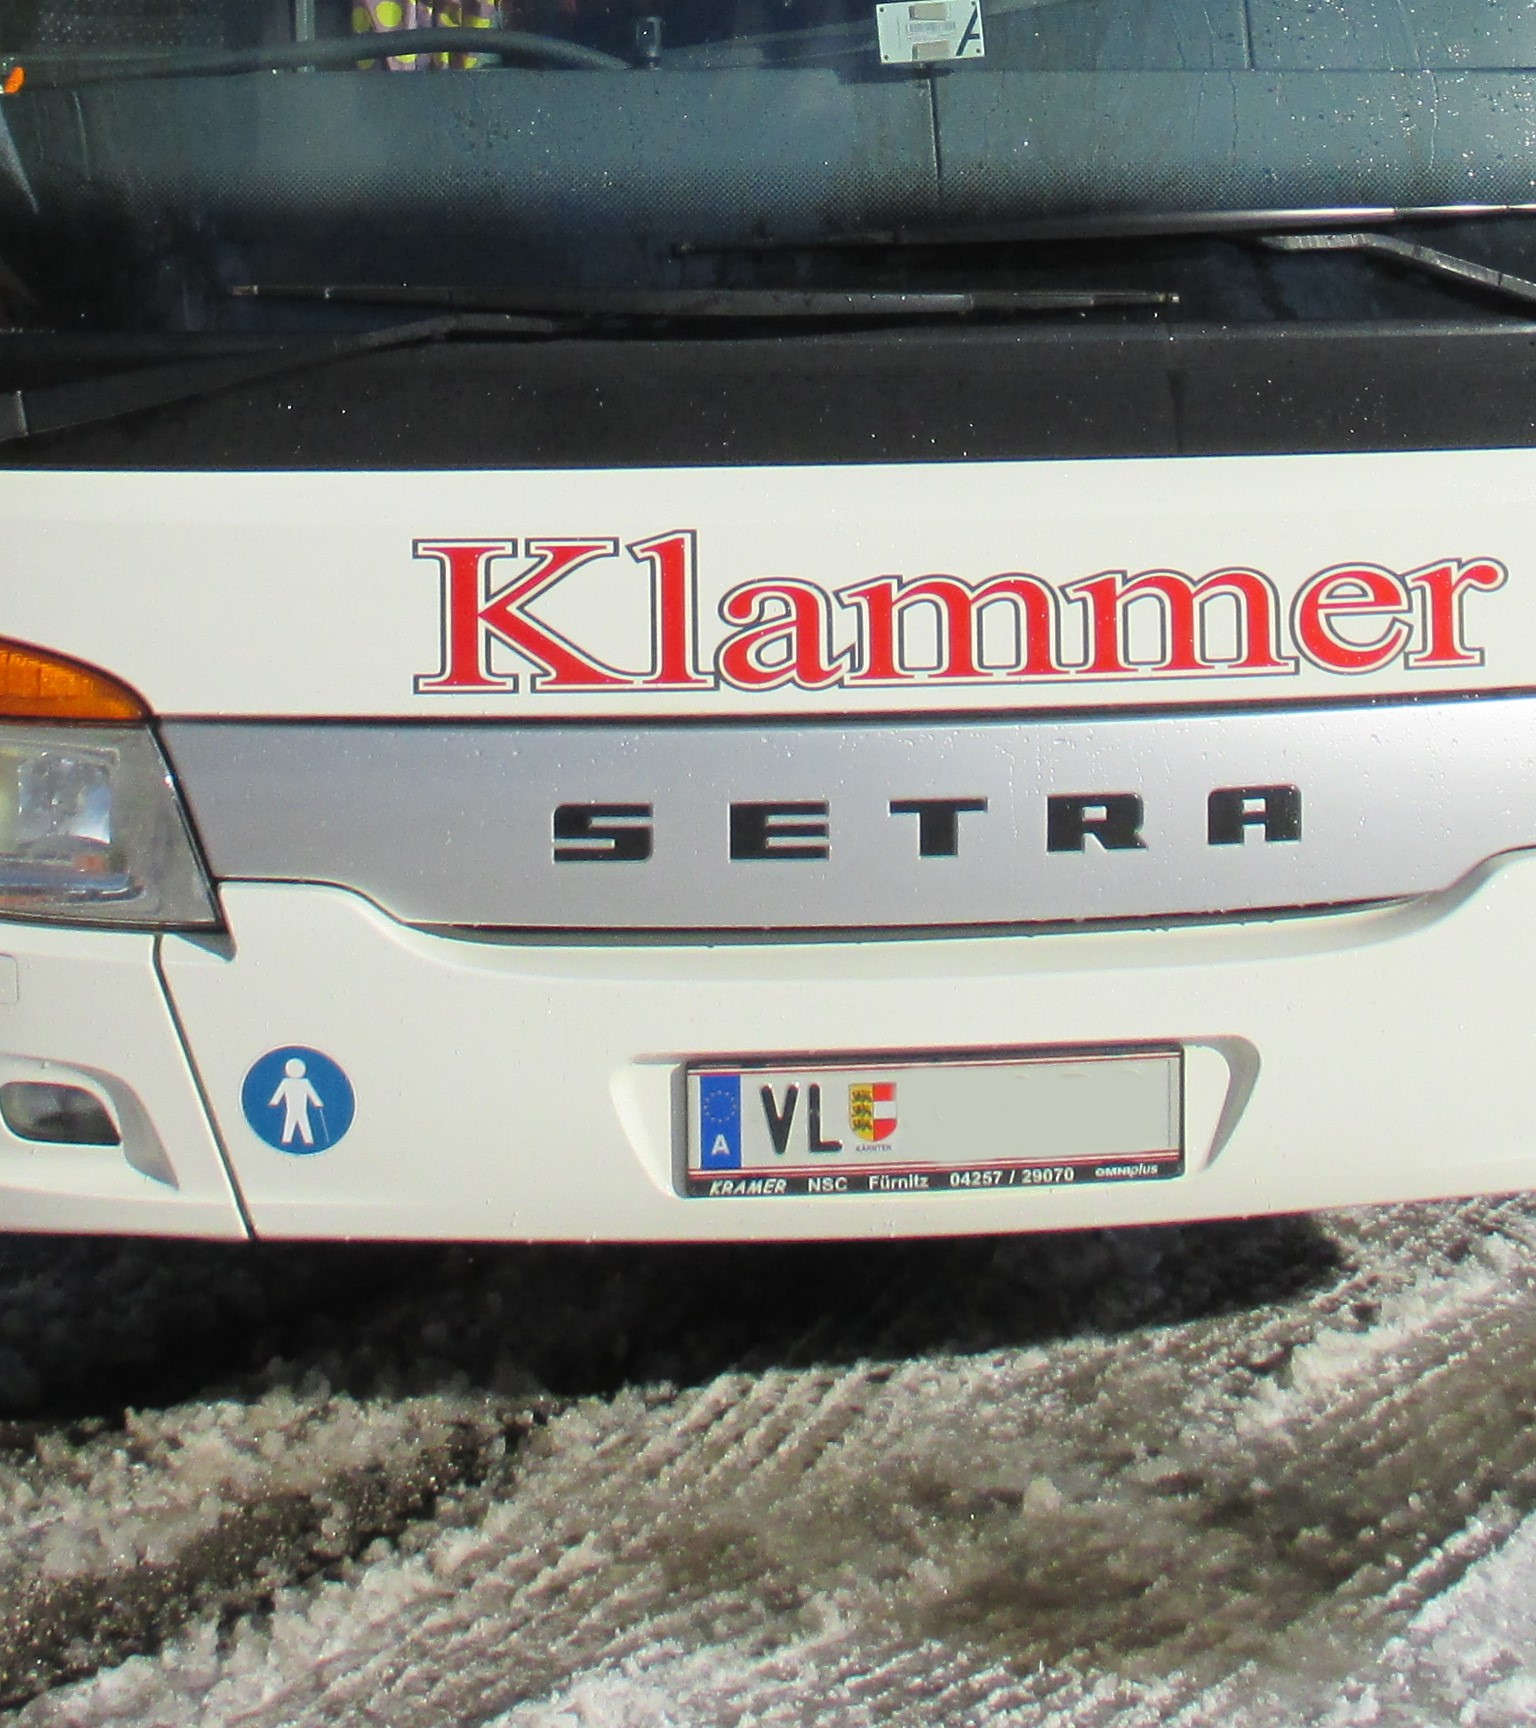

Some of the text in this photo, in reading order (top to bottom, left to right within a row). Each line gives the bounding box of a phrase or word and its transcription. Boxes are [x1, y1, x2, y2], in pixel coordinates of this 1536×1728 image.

[411, 529, 1510, 695] Klammer
[552, 783, 1305, 864] SETRA
[711, 1133, 731, 1156] A
[760, 1083, 843, 1154] VL
[709, 1178, 788, 1196] KRAMER
[808, 1176, 848, 1193] NSC
[868, 1170, 930, 1191] Fürnitz
[950, 1169, 1003, 1187] 04257
[1021, 1166, 1075, 1184] 29070
